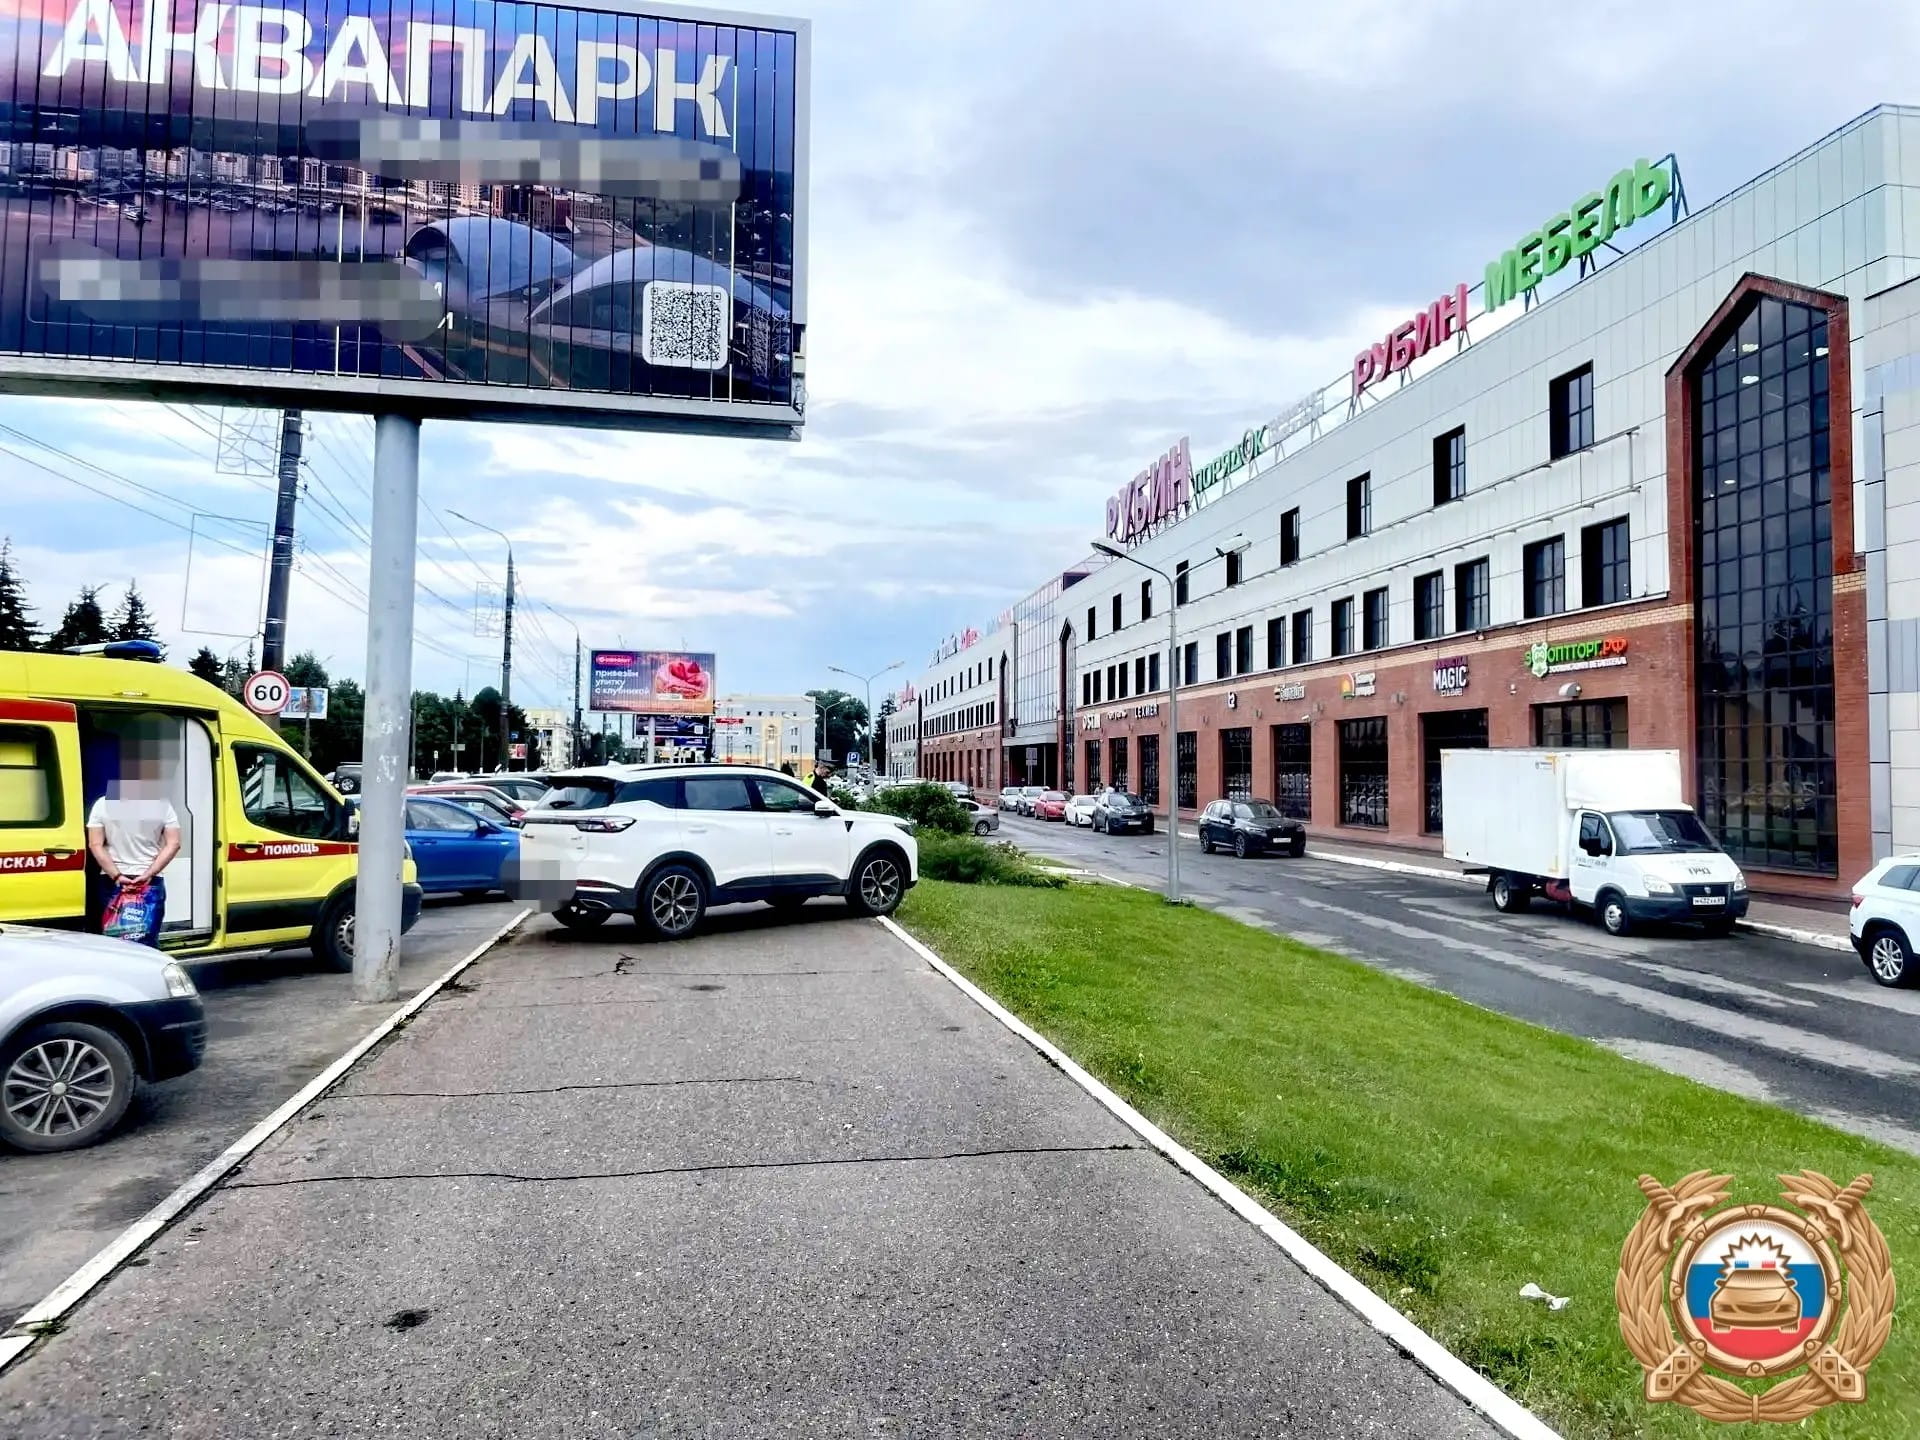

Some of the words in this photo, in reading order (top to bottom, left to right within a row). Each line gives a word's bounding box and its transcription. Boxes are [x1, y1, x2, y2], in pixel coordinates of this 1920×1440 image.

[42, 0, 733, 138] АКВАПАРК
[1352, 283, 1468, 396] РУБИН
[1484, 158, 1670, 312] МЕБЕЛЬ
[1195, 425, 1268, 493] ПОРЯДОК
[1106, 436, 1190, 543] РУБИН
[254, 684, 282, 702] 60
[594, 687, 601, 695] с
[1433, 665, 1467, 691] MAGIC
[264, 843, 320, 857] ПОМОЩЬ
